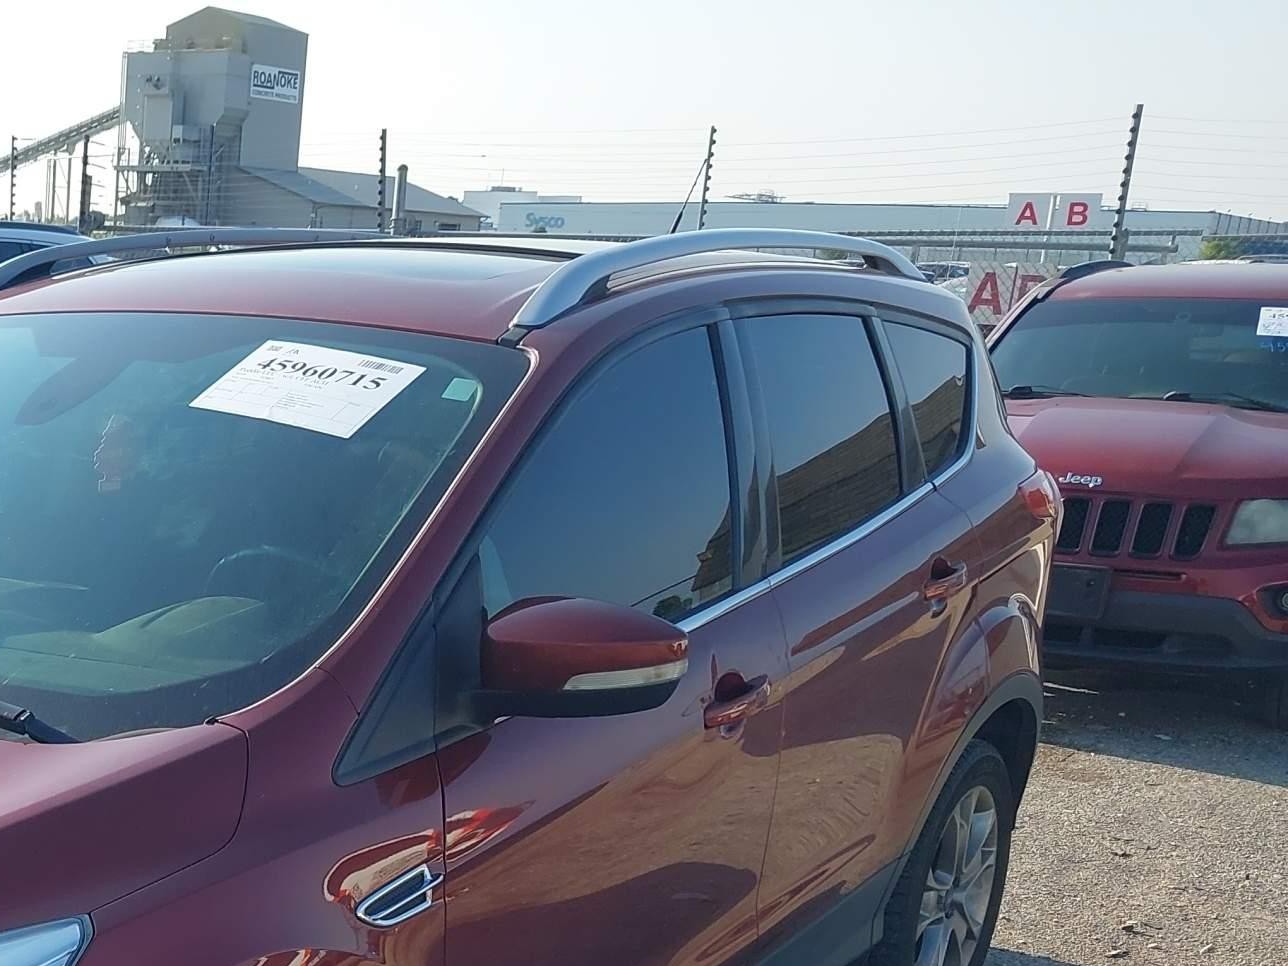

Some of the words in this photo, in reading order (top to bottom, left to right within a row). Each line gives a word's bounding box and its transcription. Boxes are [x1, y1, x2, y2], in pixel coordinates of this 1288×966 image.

[252, 70, 298, 90] ROANOKE
[1015, 201, 1038, 225] A
[1066, 201, 1089, 226] B
[968, 271, 1002, 315] A
[257, 357, 389, 391] 45960715
[1058, 472, 1103, 488] Jeep
